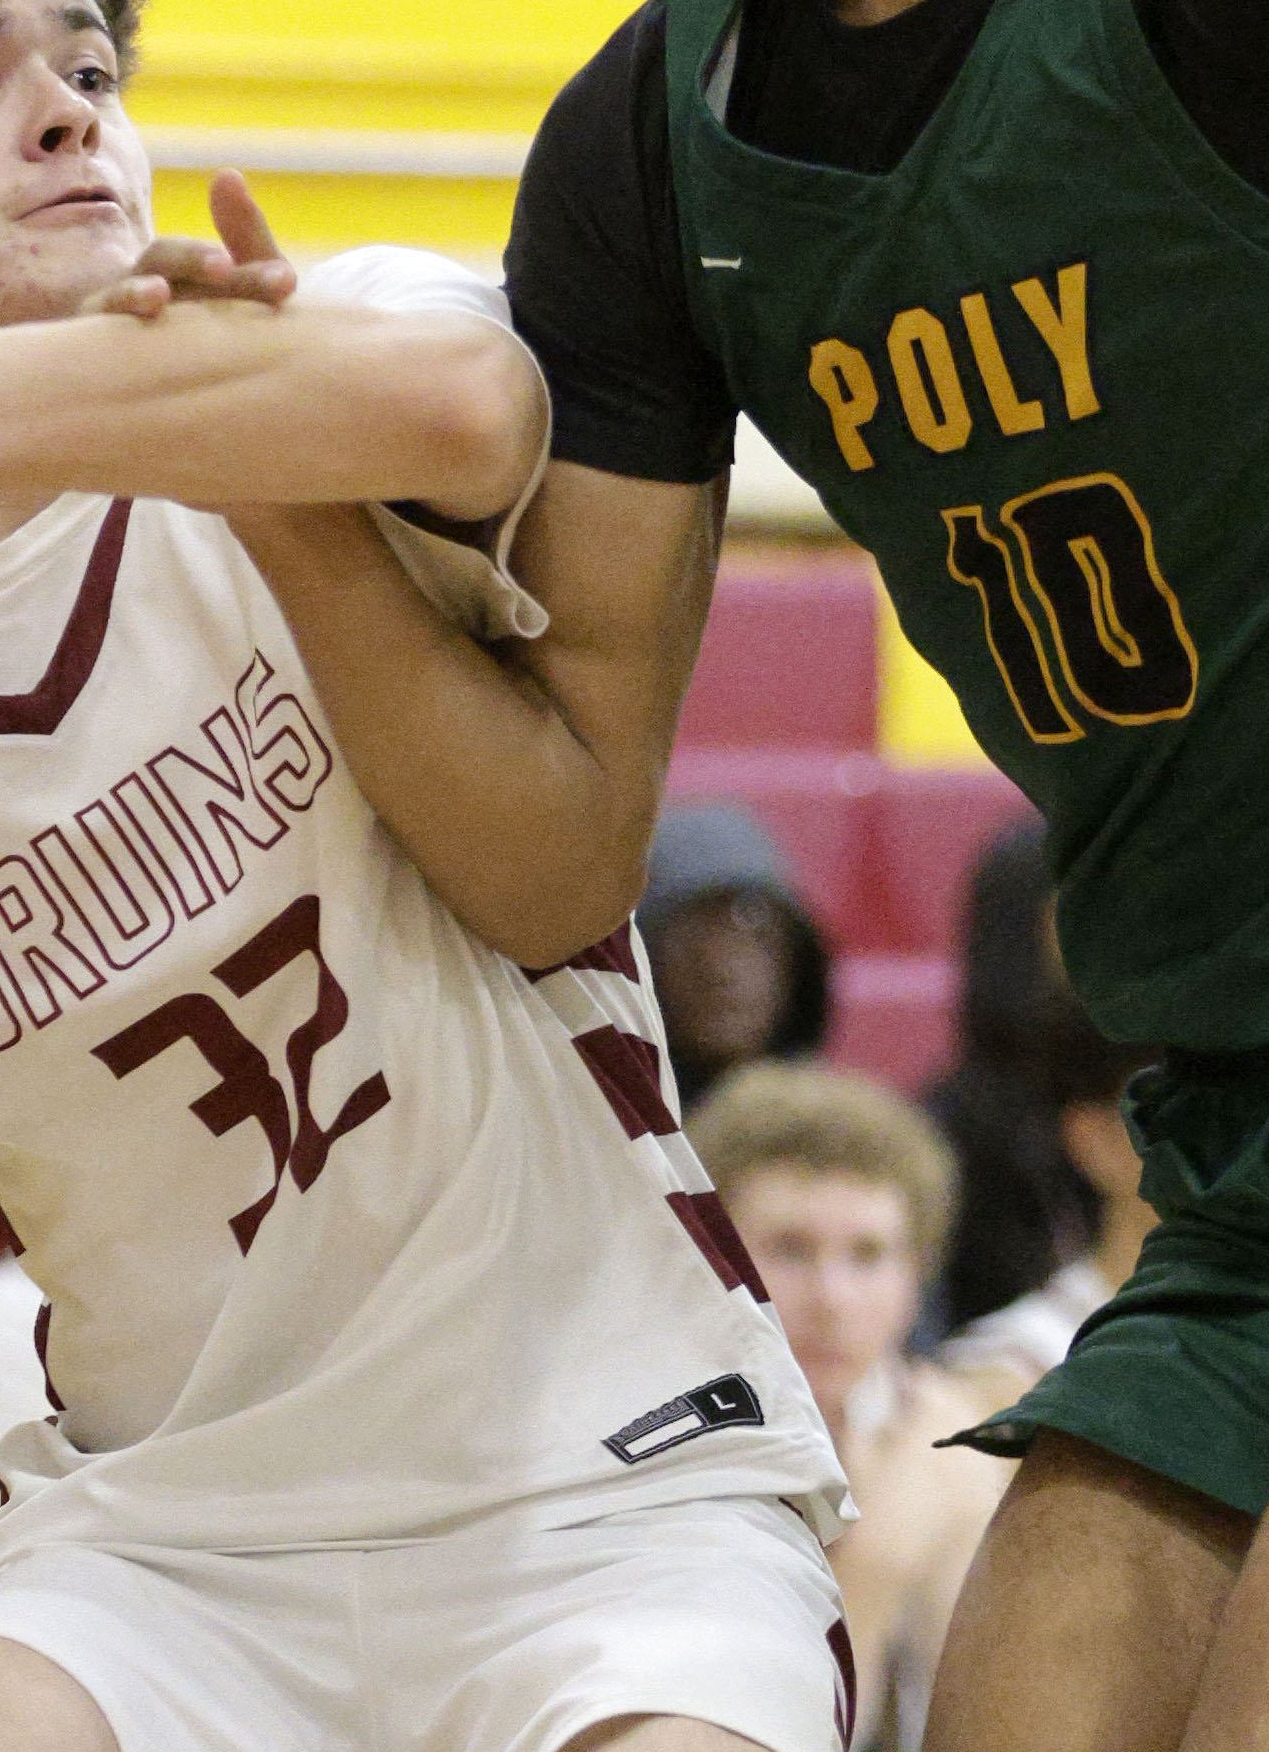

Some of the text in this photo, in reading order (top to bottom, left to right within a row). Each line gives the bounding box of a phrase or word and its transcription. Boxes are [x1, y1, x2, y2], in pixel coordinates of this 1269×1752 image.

[808, 261, 1101, 472] POLY
[940, 471, 1199, 744] 10
[89, 894, 391, 1257] 32
